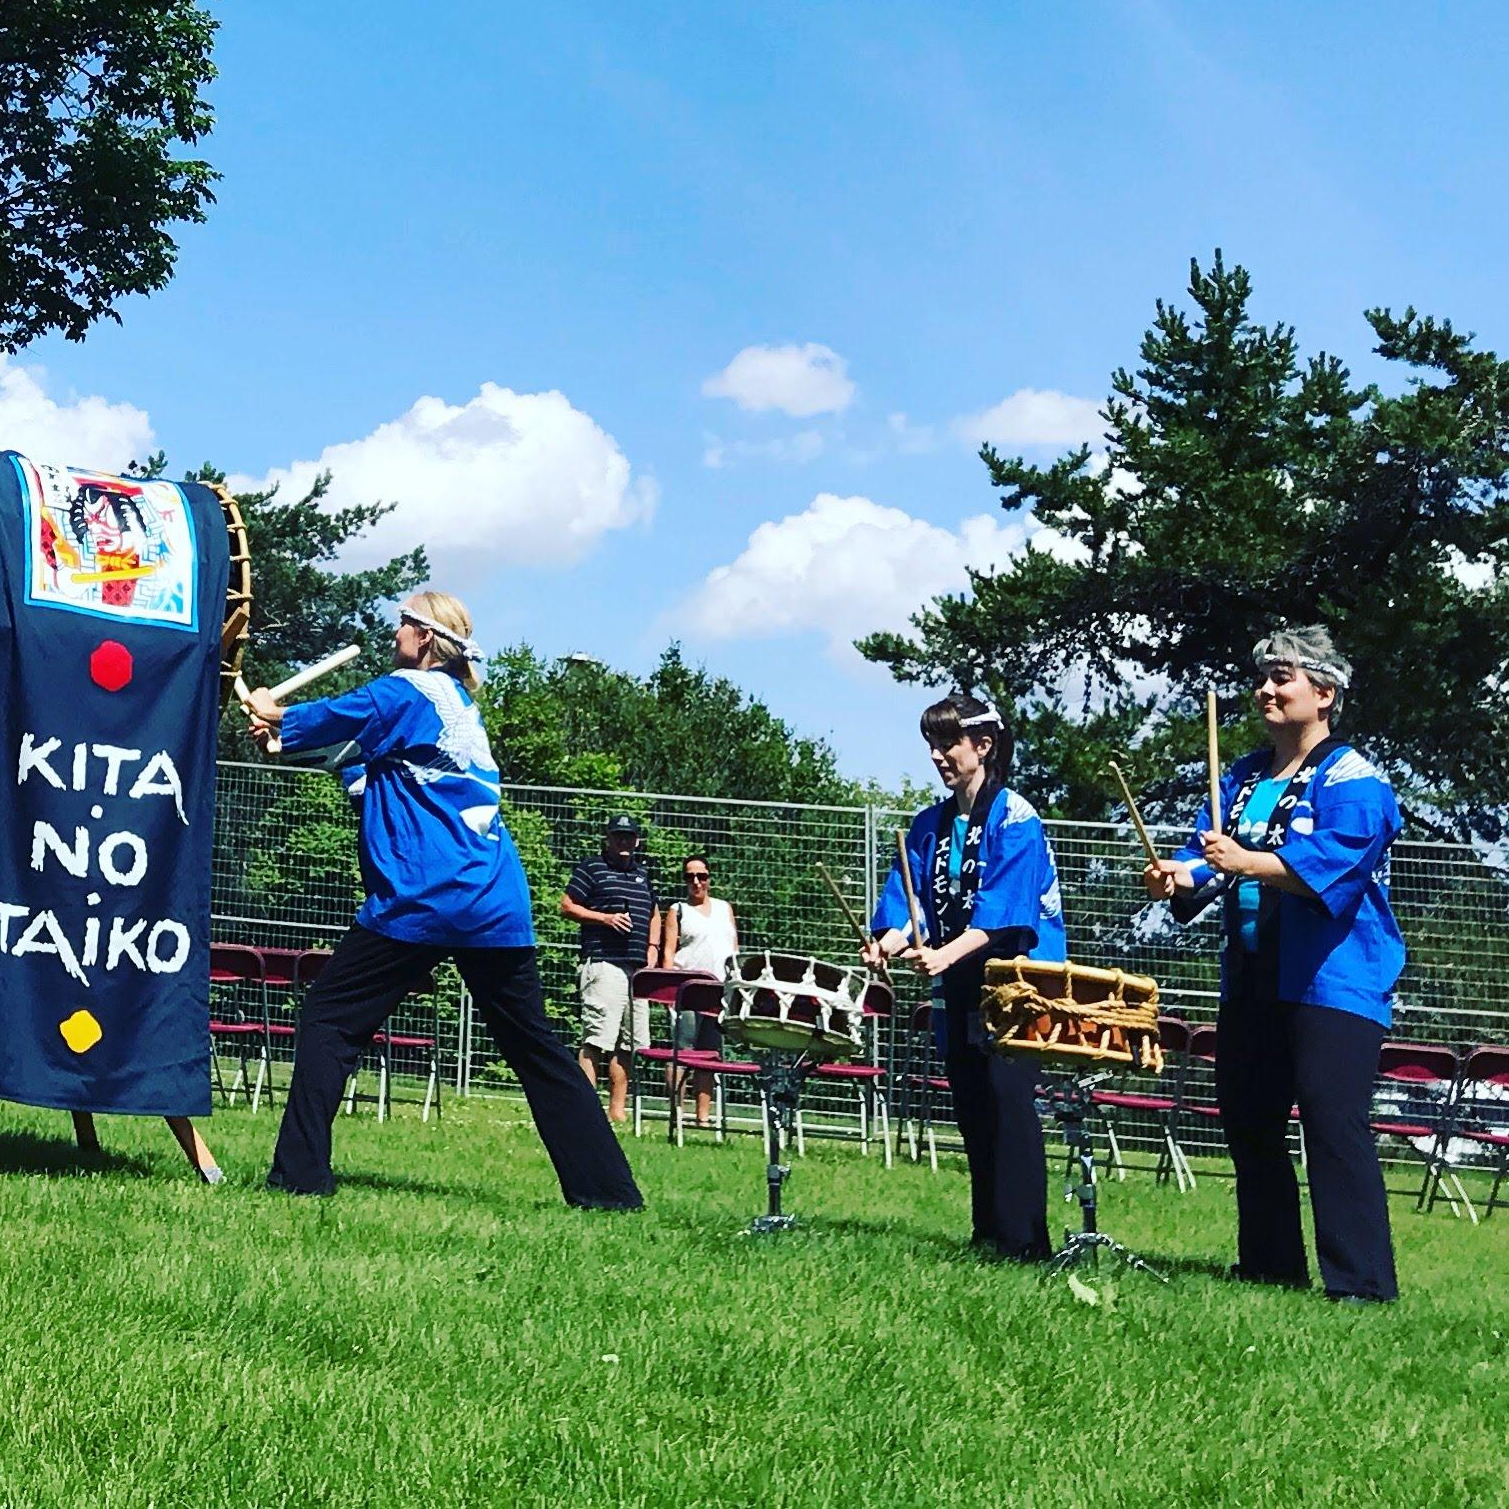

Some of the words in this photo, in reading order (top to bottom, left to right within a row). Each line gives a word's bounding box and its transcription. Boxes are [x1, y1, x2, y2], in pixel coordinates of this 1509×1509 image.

[17, 732, 189, 826] KITA
[31, 820, 148, 886] NO
[933, 836, 951, 946] エドモント
[962, 825, 983, 931] 北の太
